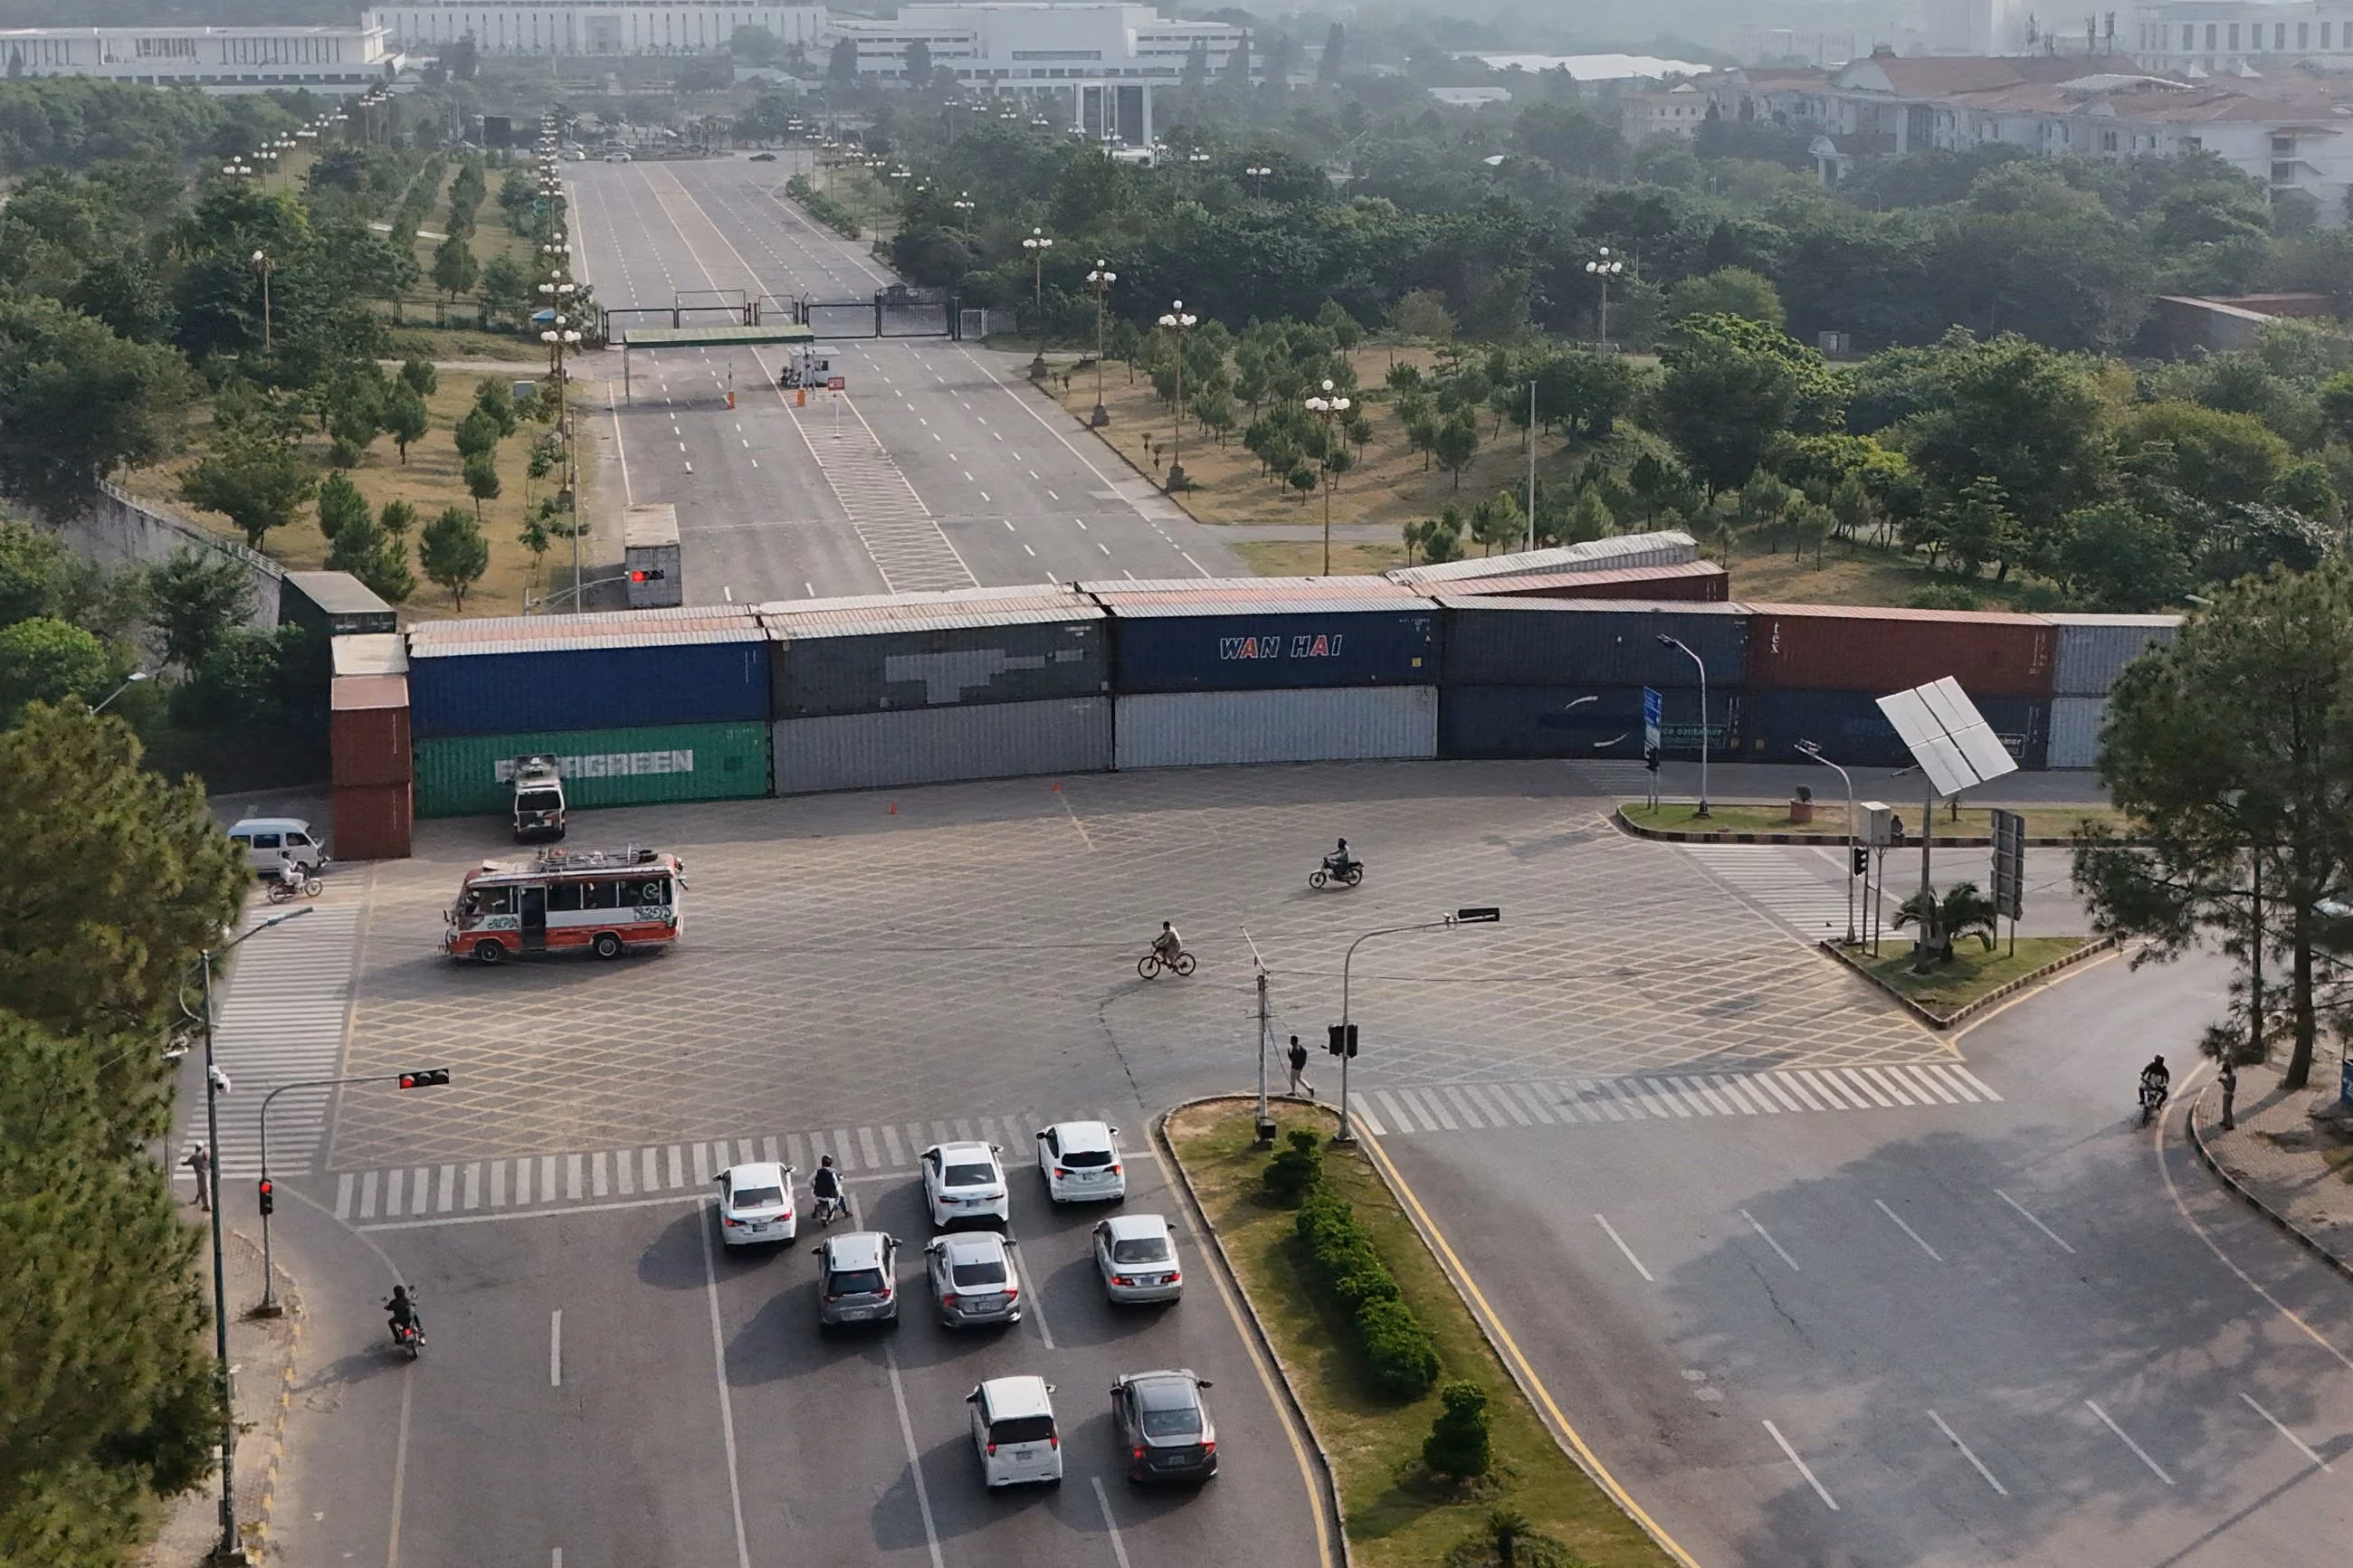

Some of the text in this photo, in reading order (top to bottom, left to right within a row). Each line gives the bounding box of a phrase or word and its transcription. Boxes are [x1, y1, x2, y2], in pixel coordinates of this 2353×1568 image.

[1220, 634, 1343, 660] WAN HAI
[494, 749, 693, 784] ERGREEN
